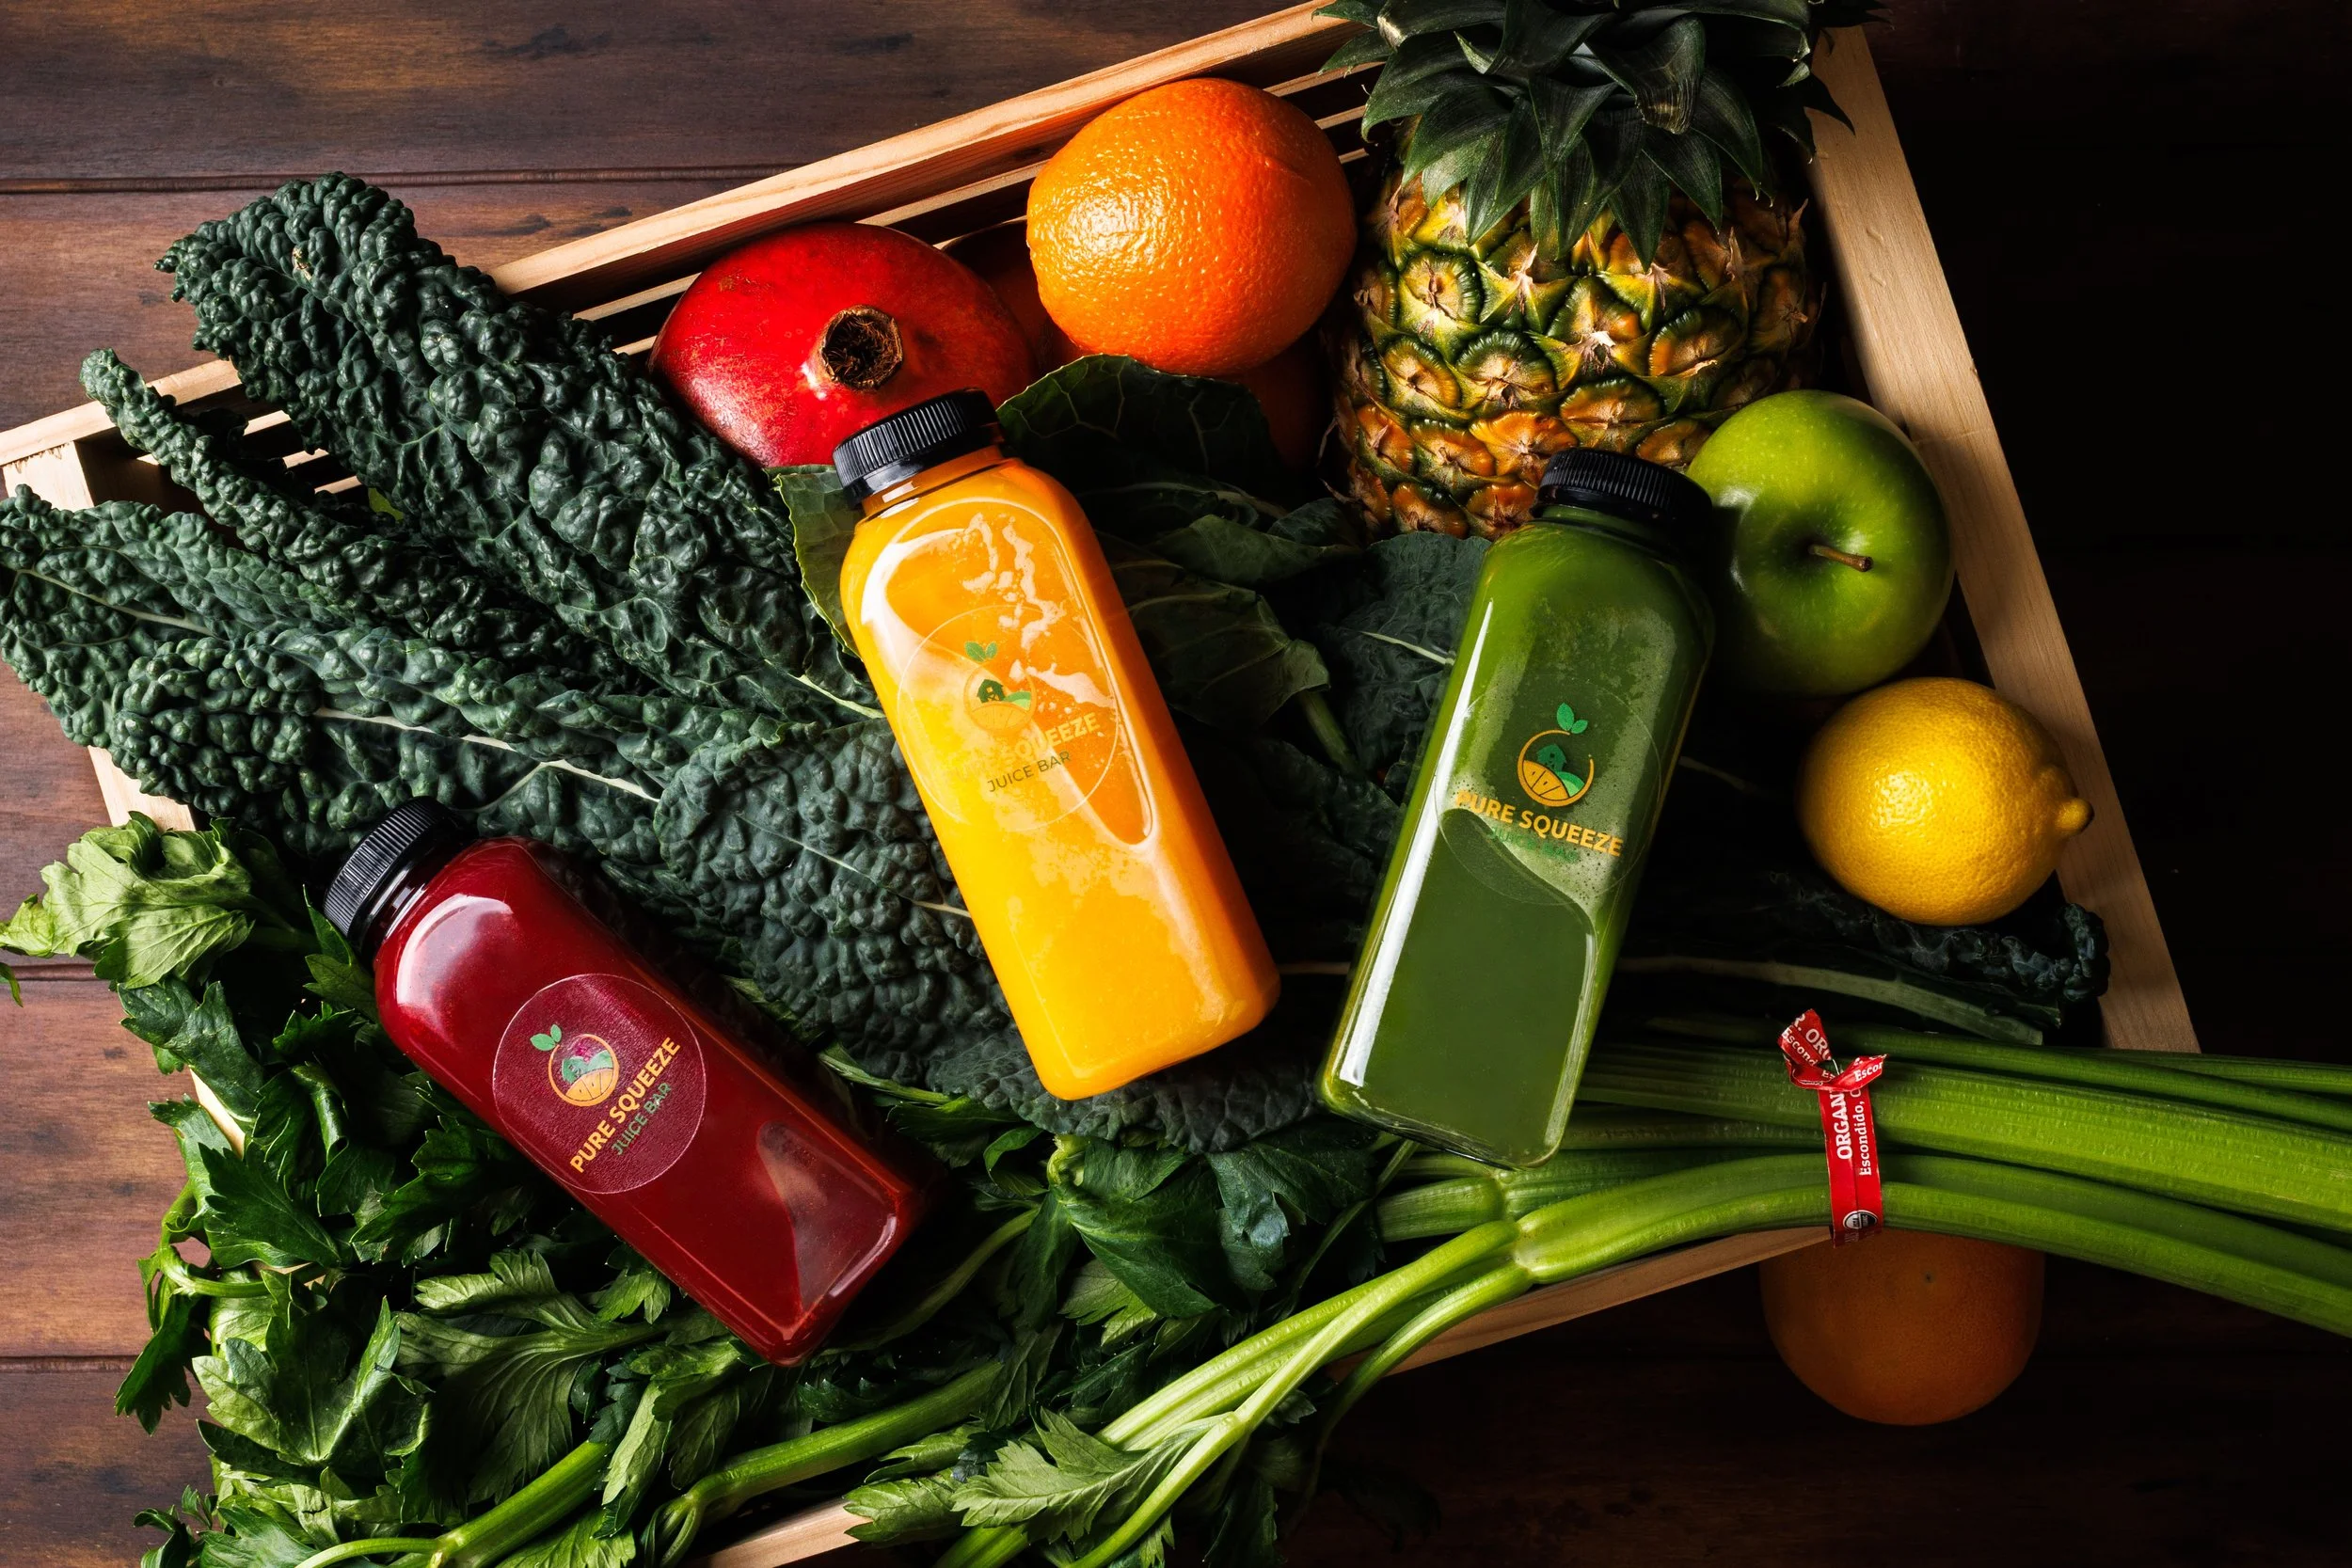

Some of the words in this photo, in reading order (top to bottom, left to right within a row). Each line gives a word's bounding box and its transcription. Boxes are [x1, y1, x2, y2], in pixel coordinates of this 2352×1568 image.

[987, 765, 1034, 793] JUICE
[1037, 751, 1071, 773] BAR
[1455, 790, 1516, 824] PURE
[1518, 810, 1624, 857] SQUEEZE
[570, 1120, 616, 1173] PURE
[610, 1037, 680, 1124] SQUEEZE
[612, 1113, 648, 1156] JUICE
[644, 1083, 672, 1115] BAR
[1829, 1088, 1852, 1160] ORGAN
[1852, 1101, 1872, 1176] Escondido,
